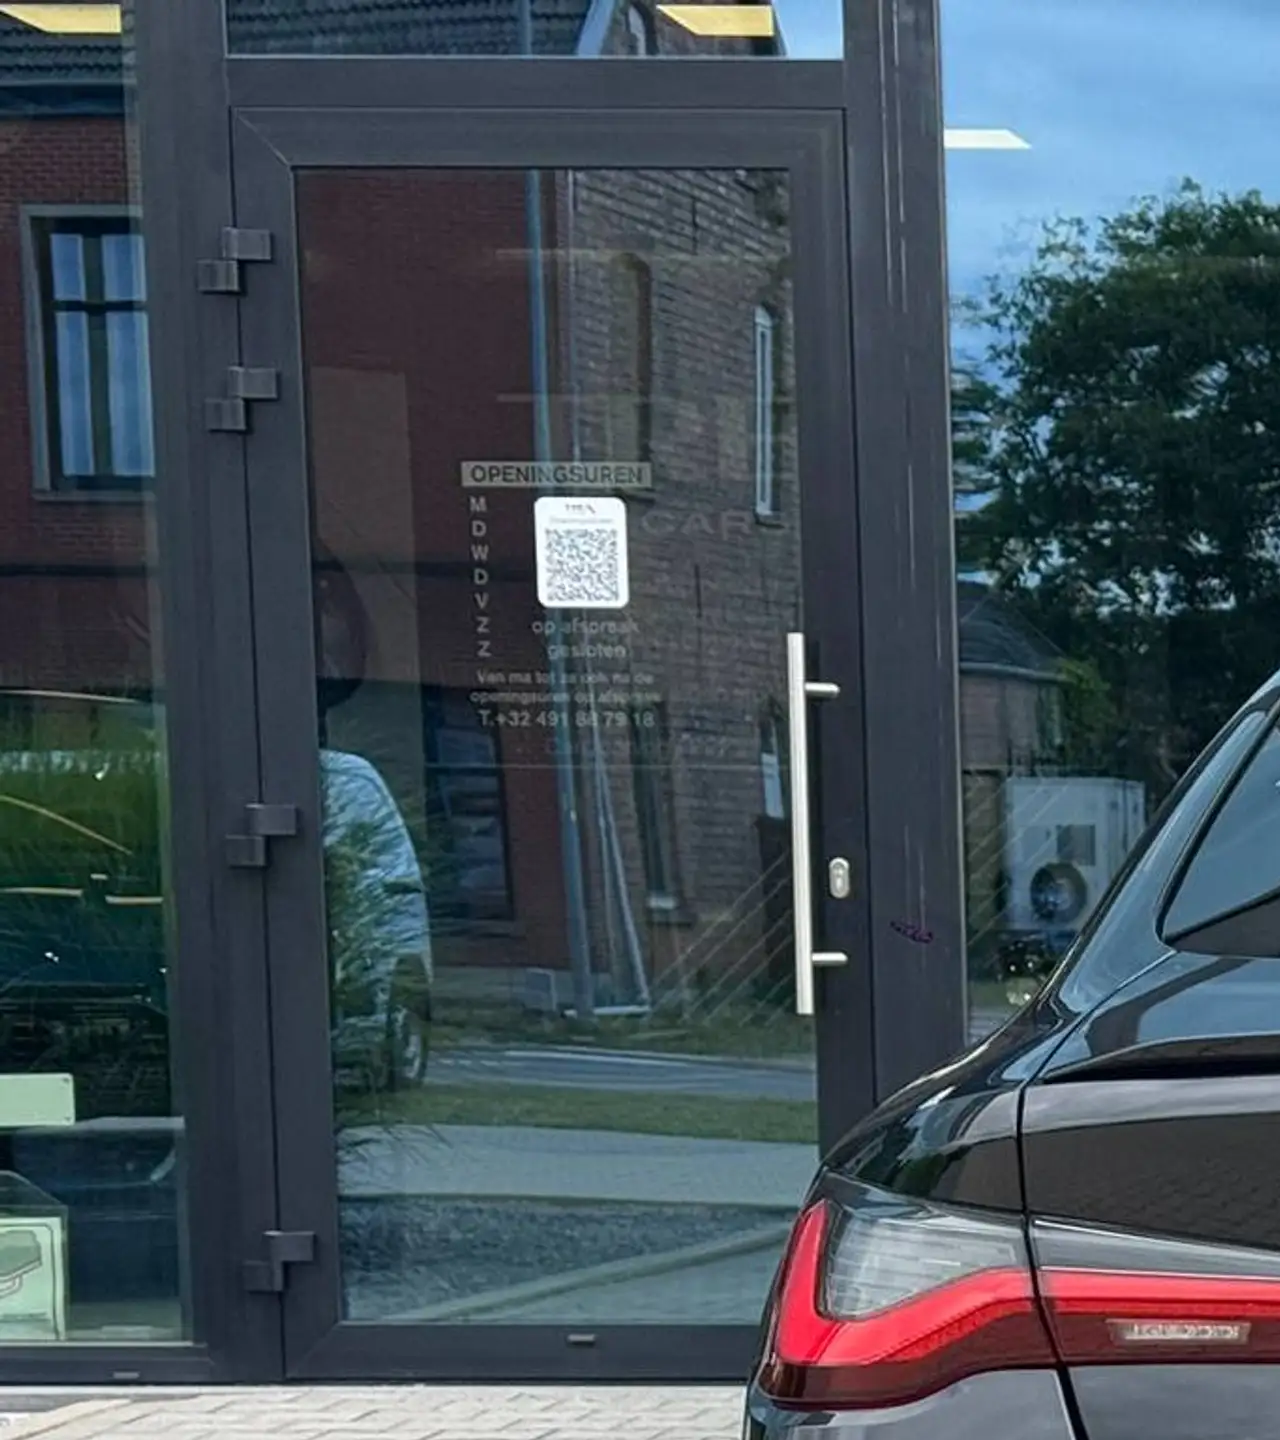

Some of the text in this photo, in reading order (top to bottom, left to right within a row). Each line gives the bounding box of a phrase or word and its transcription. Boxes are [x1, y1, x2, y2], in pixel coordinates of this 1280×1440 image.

[471, 465, 642, 483] OPENINGSUREN
[470, 497, 487, 513] M
[472, 520, 487, 537] D
[471, 545, 489, 561] W
[473, 568, 488, 585] D
[474, 593, 489, 609] V
[476, 617, 490, 633] Z
[477, 641, 491, 657] Z
